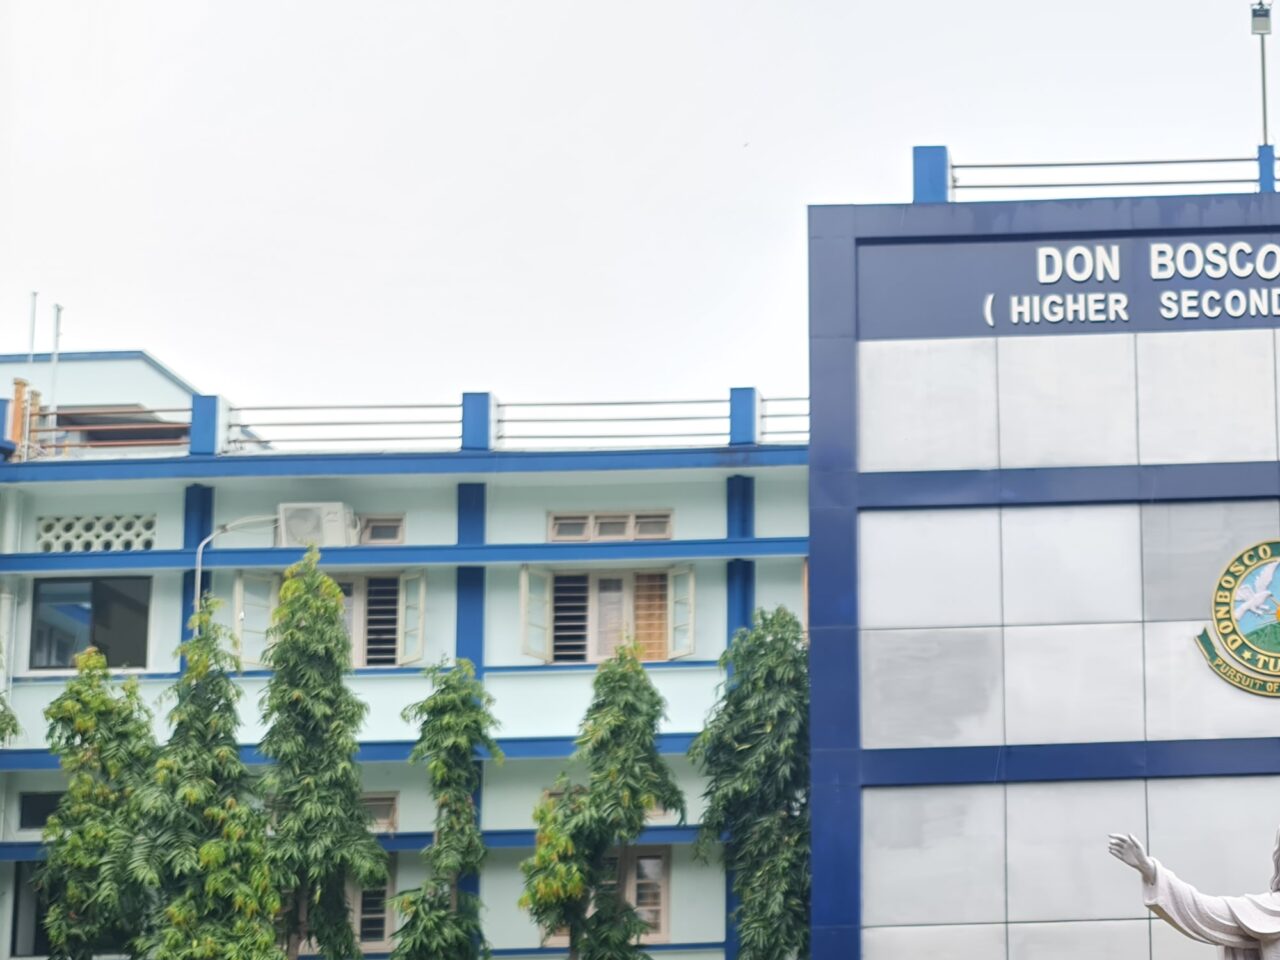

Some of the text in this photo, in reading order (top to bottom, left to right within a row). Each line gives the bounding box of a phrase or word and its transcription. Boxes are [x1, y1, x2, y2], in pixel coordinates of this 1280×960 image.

[1037, 245, 1121, 284] DON
[1212, 657, 1263, 690] PURSUIT
[1266, 682, 1280, 693] OF
